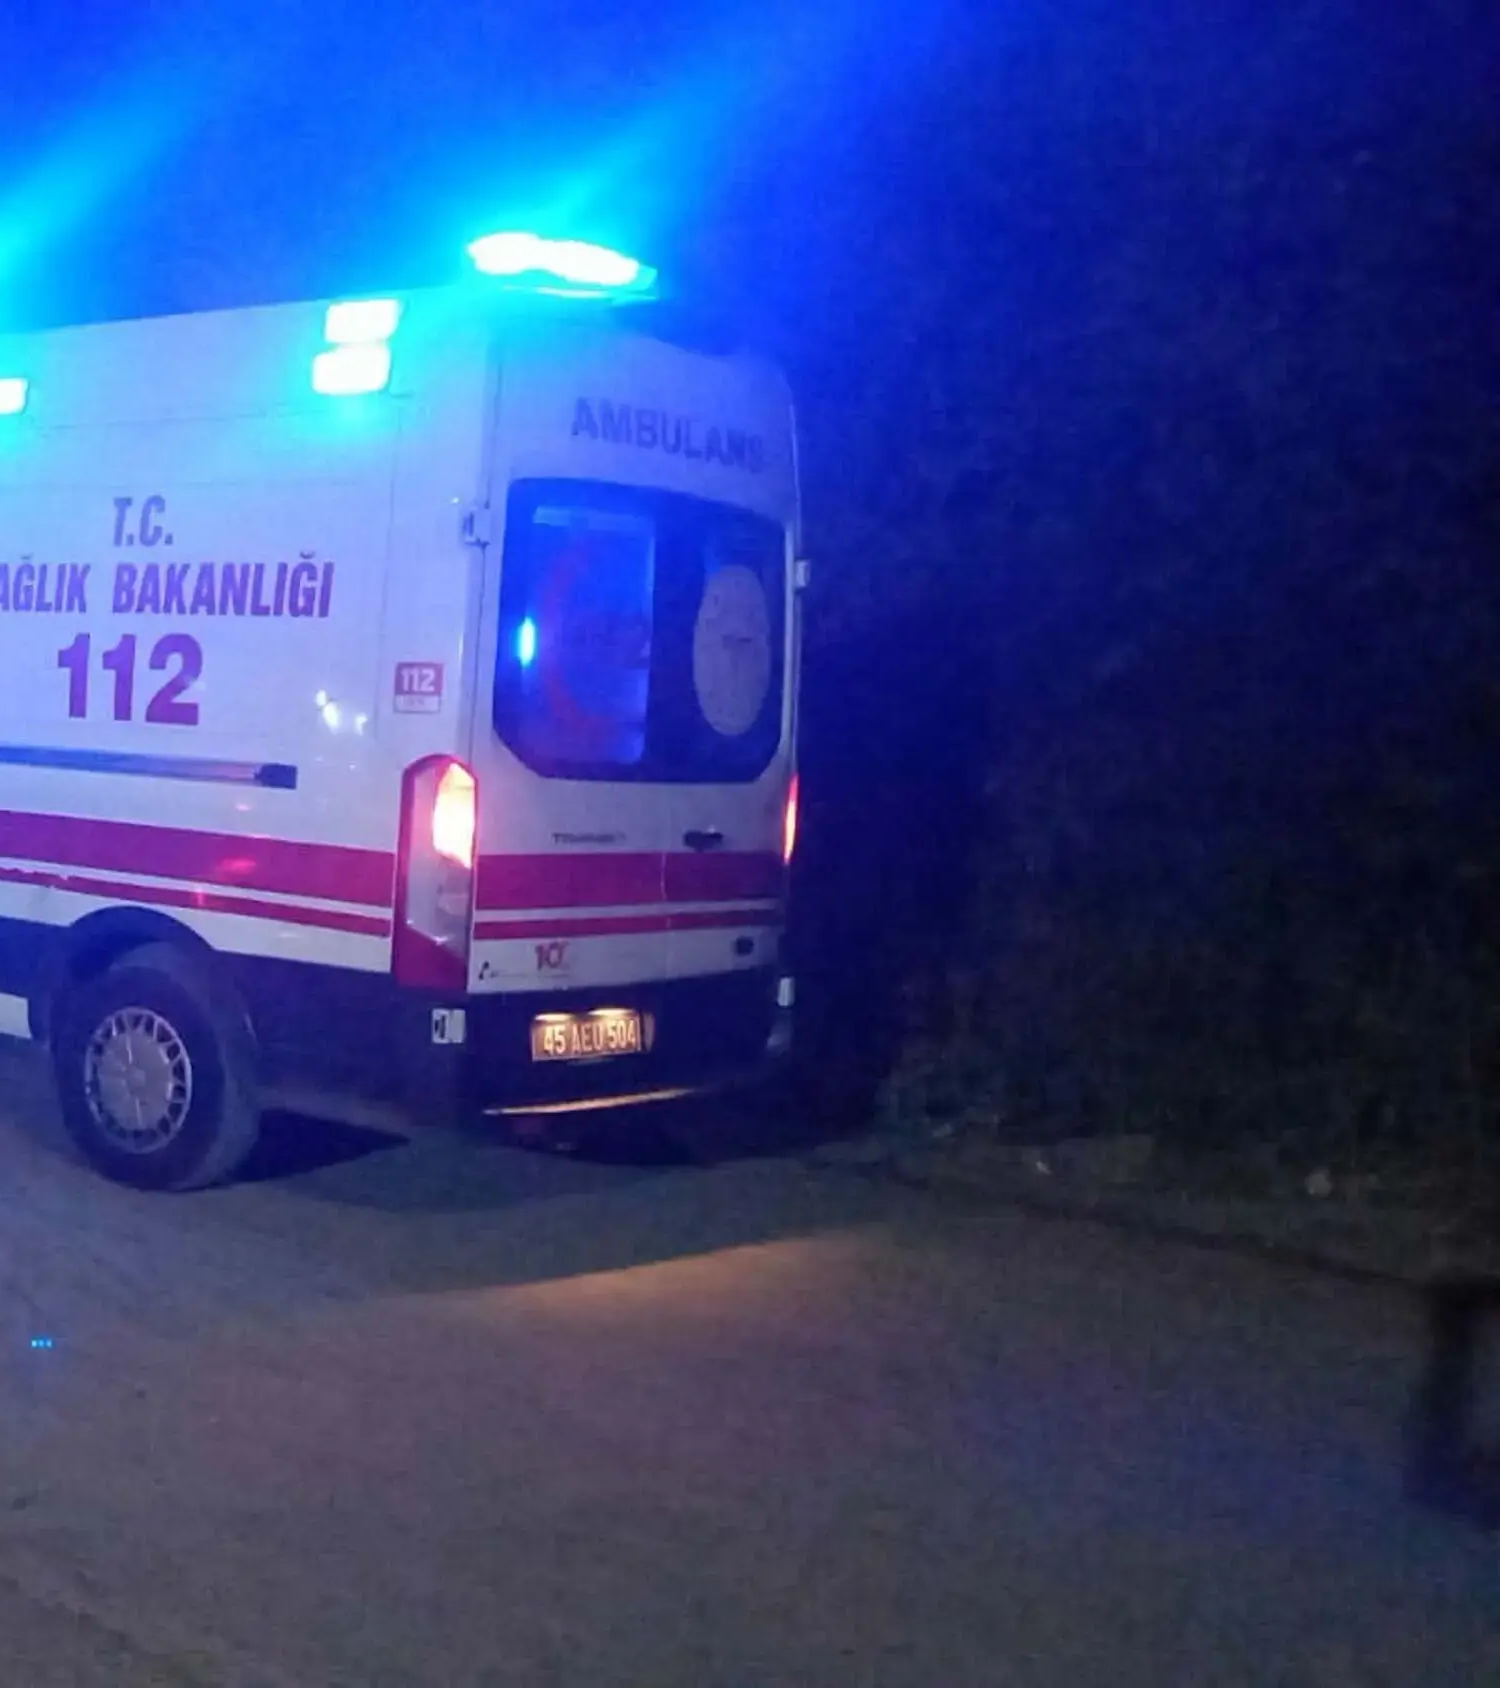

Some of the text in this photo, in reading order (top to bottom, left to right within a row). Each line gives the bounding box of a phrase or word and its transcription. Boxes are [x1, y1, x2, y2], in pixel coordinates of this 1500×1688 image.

[112, 495, 174, 547] T.C.
[112, 551, 335, 618] BAKANLIĞI
[58, 632, 204, 727] 112
[402, 668, 435, 692] 112
[543, 1023, 566, 1056] 45
[607, 1018, 637, 1050] 504
